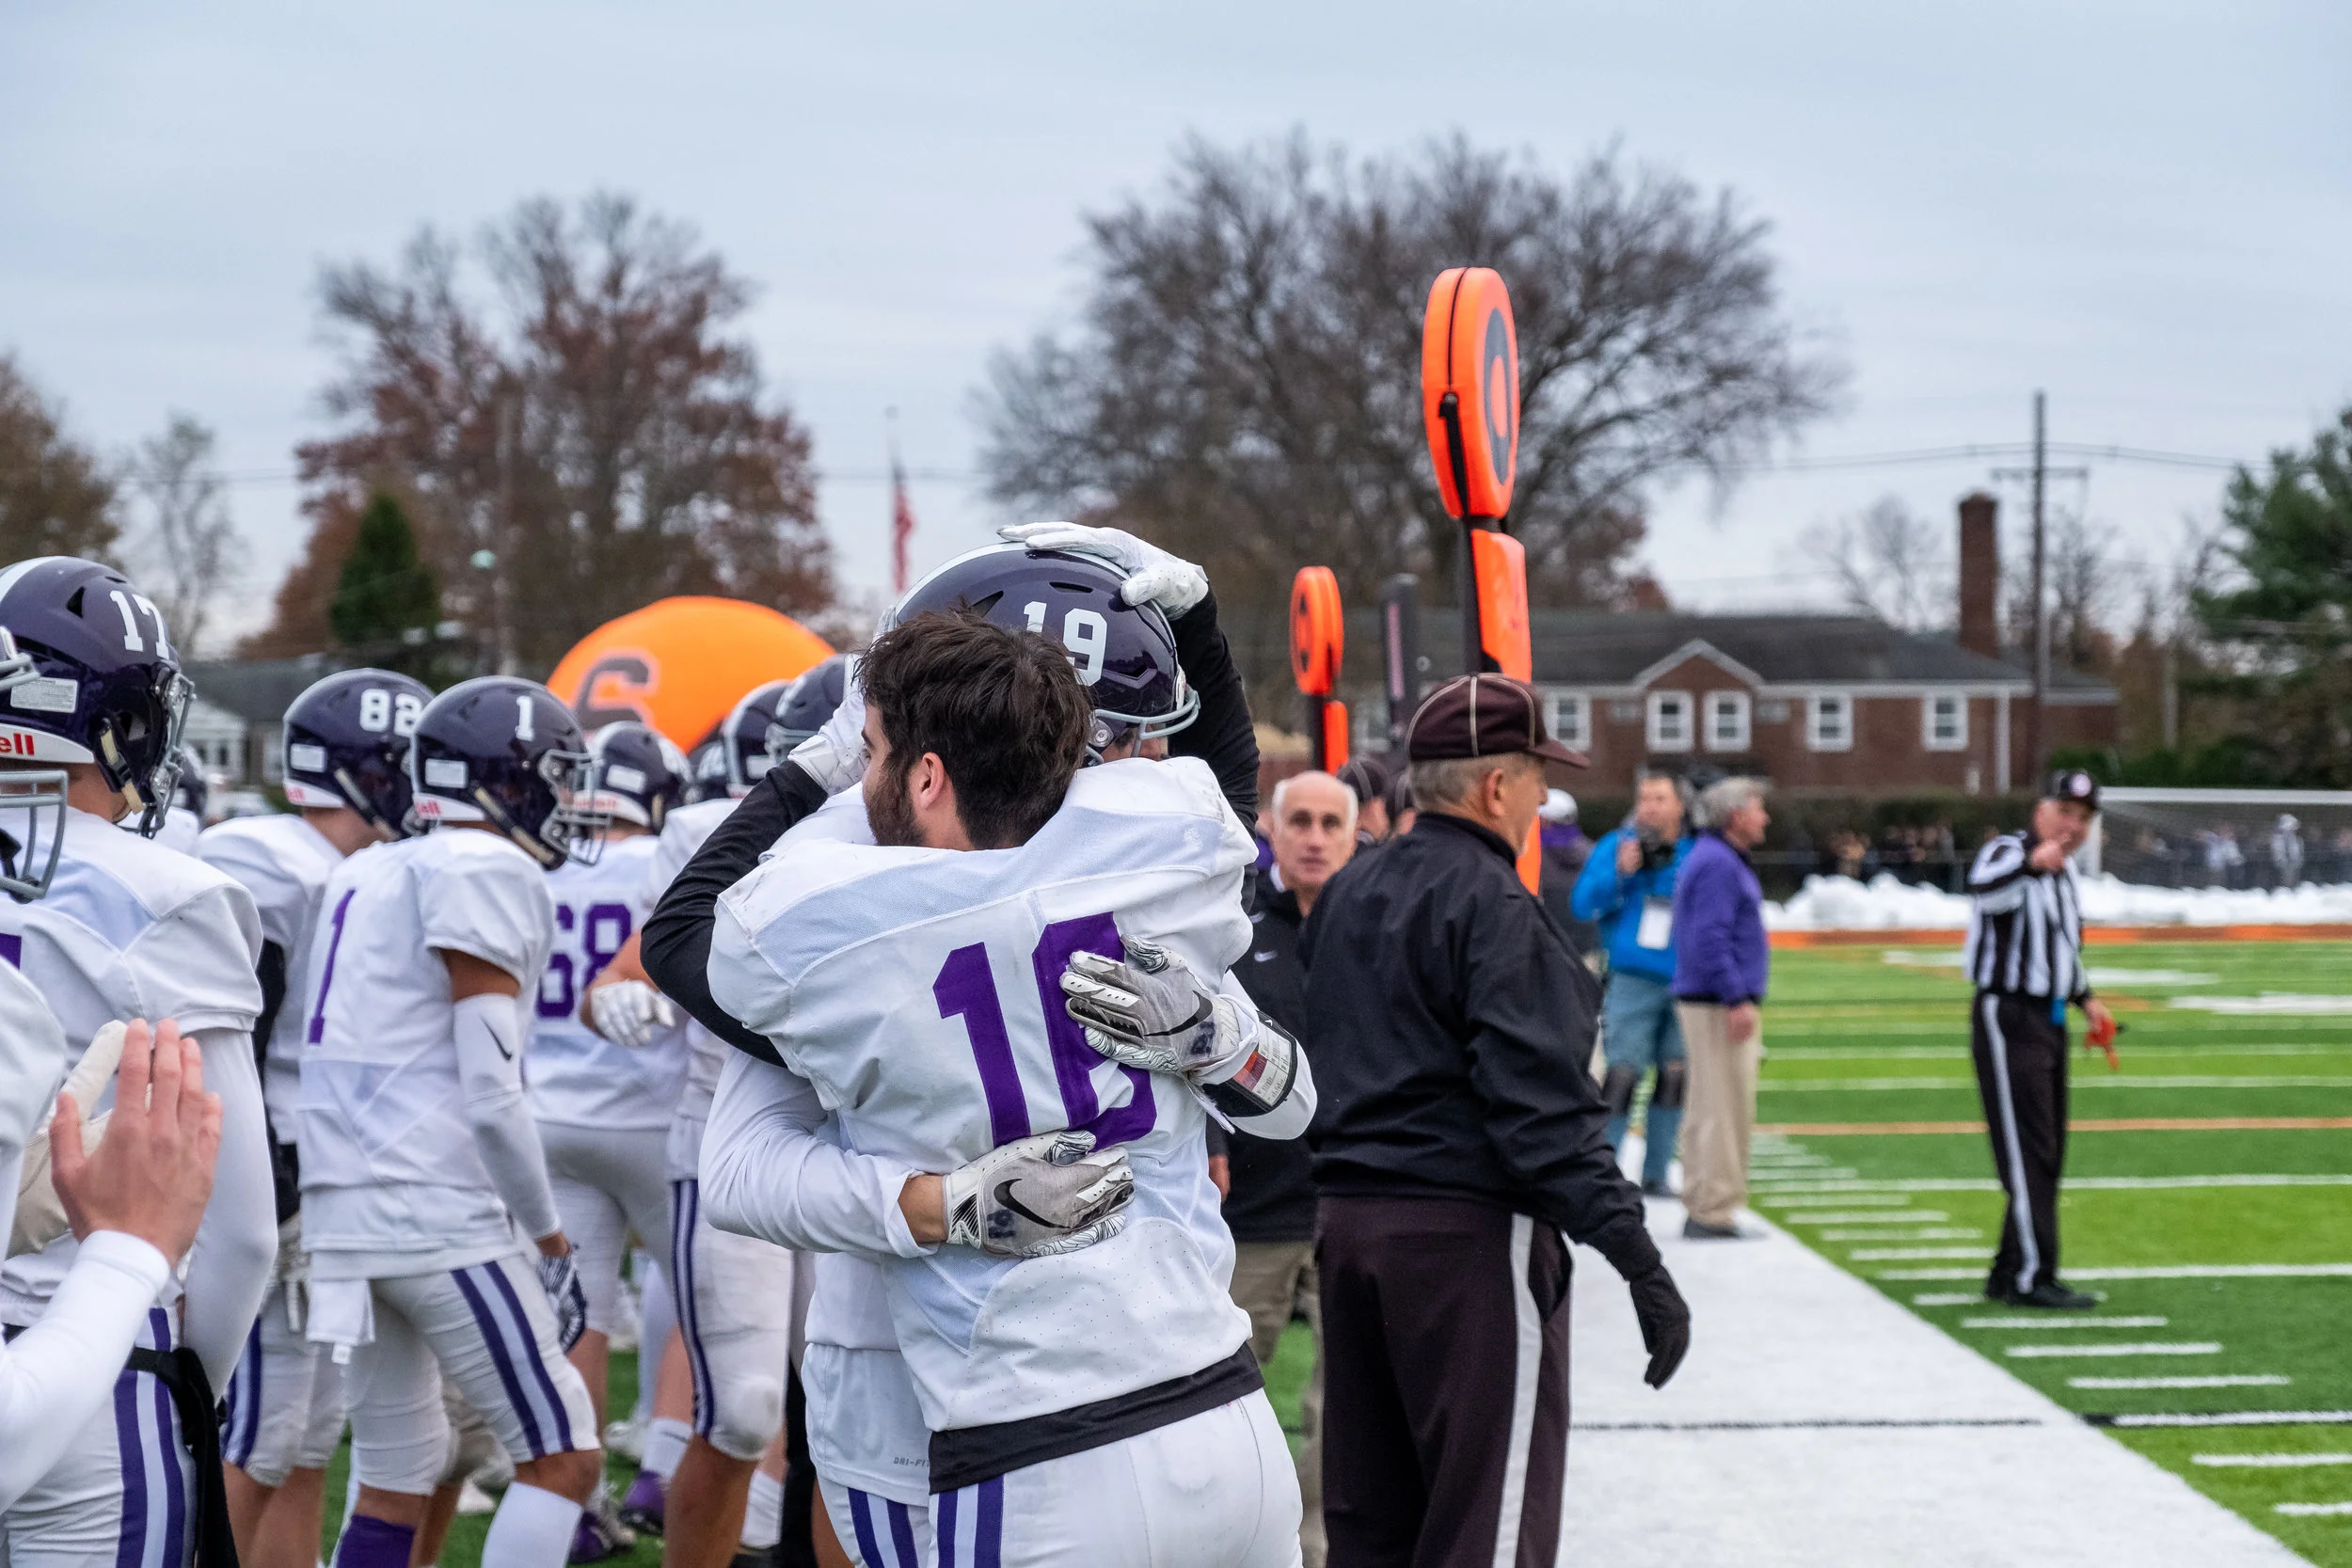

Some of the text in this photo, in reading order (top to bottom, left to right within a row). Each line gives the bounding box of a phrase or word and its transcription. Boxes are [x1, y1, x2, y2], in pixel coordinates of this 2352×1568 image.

[110, 591, 169, 659] 17
[359, 688, 422, 737] 82
[516, 695, 535, 742] 1
[309, 888, 357, 1043] 1
[932, 911, 1157, 1153] 16
